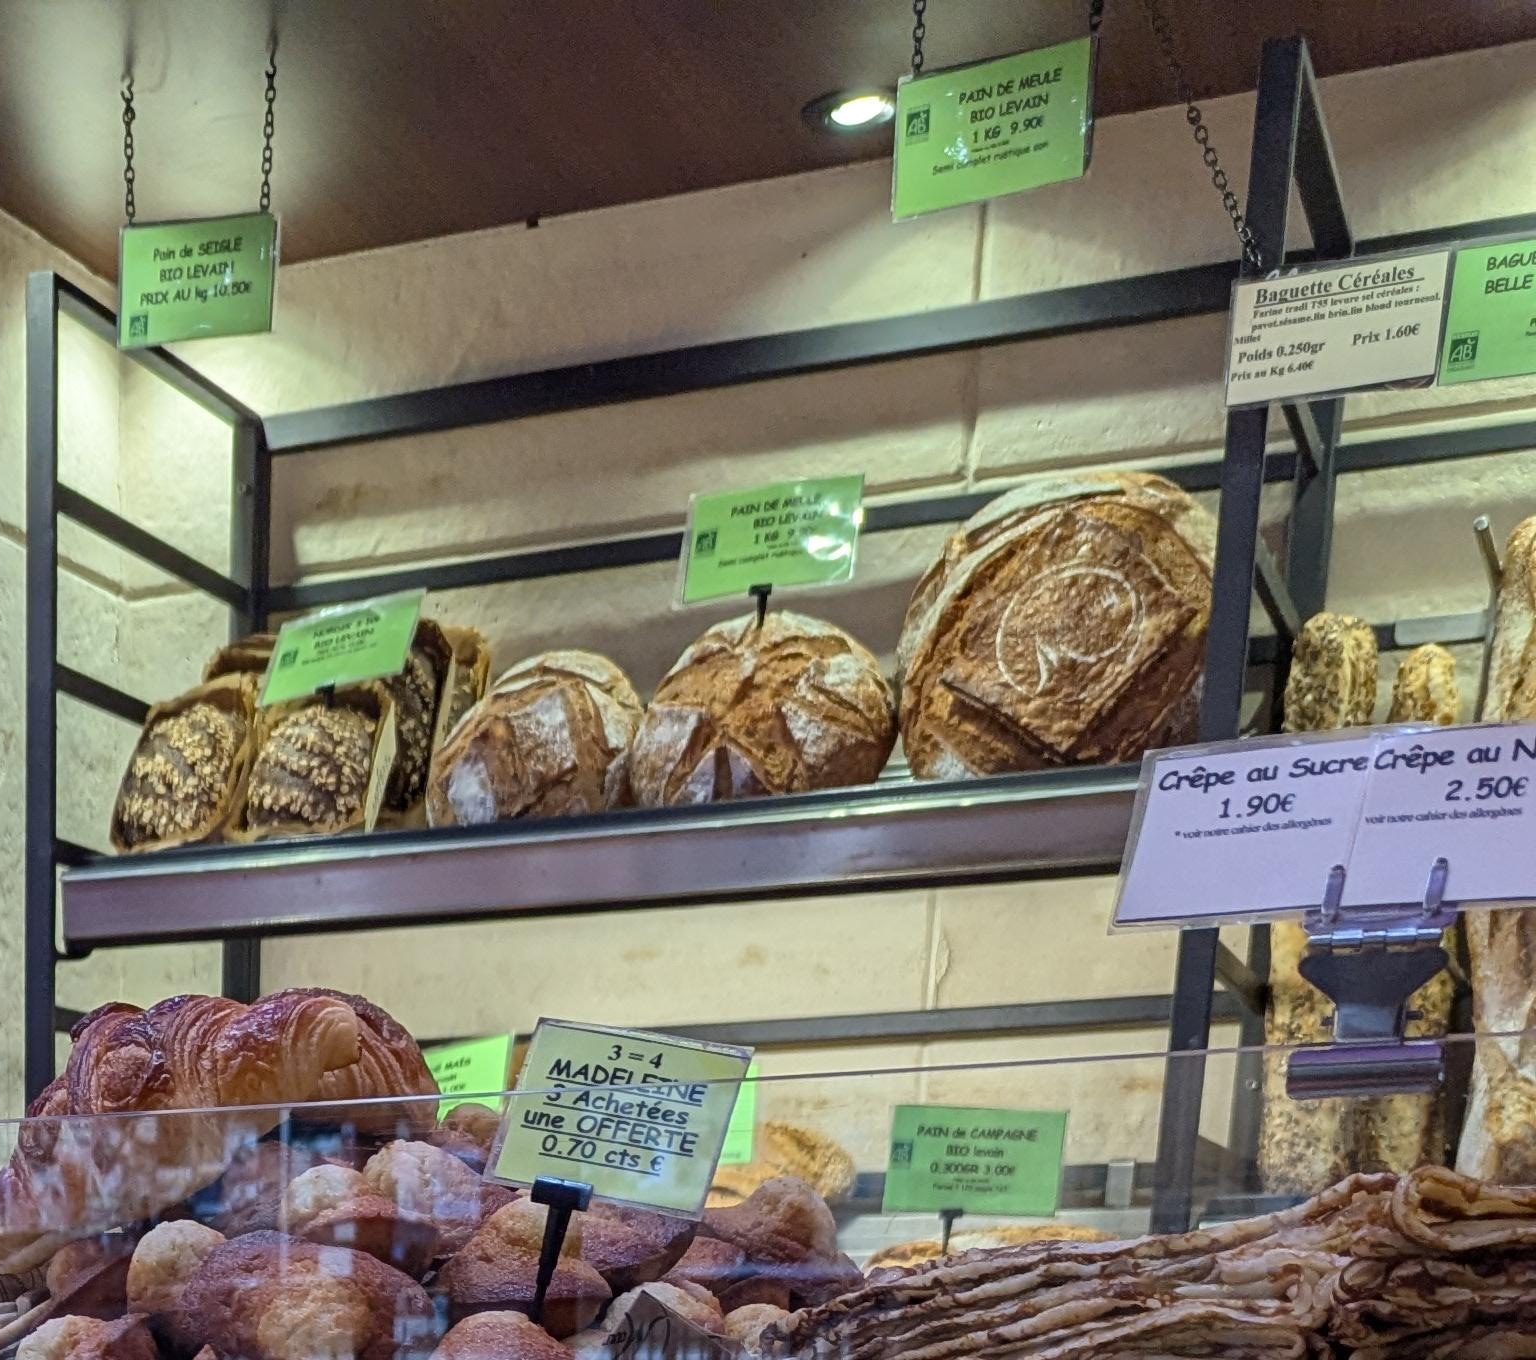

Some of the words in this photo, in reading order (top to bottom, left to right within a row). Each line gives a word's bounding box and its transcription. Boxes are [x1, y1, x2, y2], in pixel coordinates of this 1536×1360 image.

[959, 86, 993, 105] PAIN
[996, 82, 1014, 97] DE
[1018, 67, 1063, 89] MEULE
[970, 109, 995, 124] BIO
[999, 92, 1050, 117] LEVAIN
[972, 130, 979, 144] 1
[984, 126, 1001, 141] KG
[153, 247, 176, 262] Pain
[180, 244, 193, 258] de
[159, 268, 183, 282] BIO
[1253, 278, 1332, 307] Baguette
[1337, 264, 1415, 292] Céréales
[1484, 274, 1534, 294] BELLE
[140, 291, 169, 306] PRIX
[173, 288, 191, 301] AU
[1252, 308, 1283, 319] Farine
[1238, 348, 1273, 365] Poids
[1276, 340, 1326, 359] 0.250gr
[1351, 331, 1381, 347] Prix
[1385, 323, 1421, 342] 1.60€
[1230, 370, 1252, 383] Prix
[1254, 368, 1267, 378] au
[1269, 363, 1285, 378] Kg
[730, 504, 761, 518] PAIN
[753, 517, 775, 529] BIO
[1374, 744, 1455, 774] Crêpe
[1467, 746, 1501, 764] au
[1158, 767, 1235, 793] Crêpe
[1247, 764, 1278, 783] au
[1288, 756, 1368, 778] Sucre
[1445, 775, 1529, 801] 2.50€
[1218, 792, 1296, 819] 1.90€
[608, 1045, 622, 1061] 3
[648, 1052, 663, 1069] 4
[545, 1084, 561, 1102] 3
[572, 1091, 689, 1125] Achetées
[523, 1108, 565, 1128] une
[576, 1116, 699, 1153] OFFERTE
[916, 1125, 949, 1138] PAIN
[969, 1128, 1040, 1142] CAMPAGNE
[541, 1134, 596, 1160] 0.70
[604, 1149, 641, 1168] cts
[649, 1155, 663, 1172] €
[946, 1144, 970, 1157] BIO
